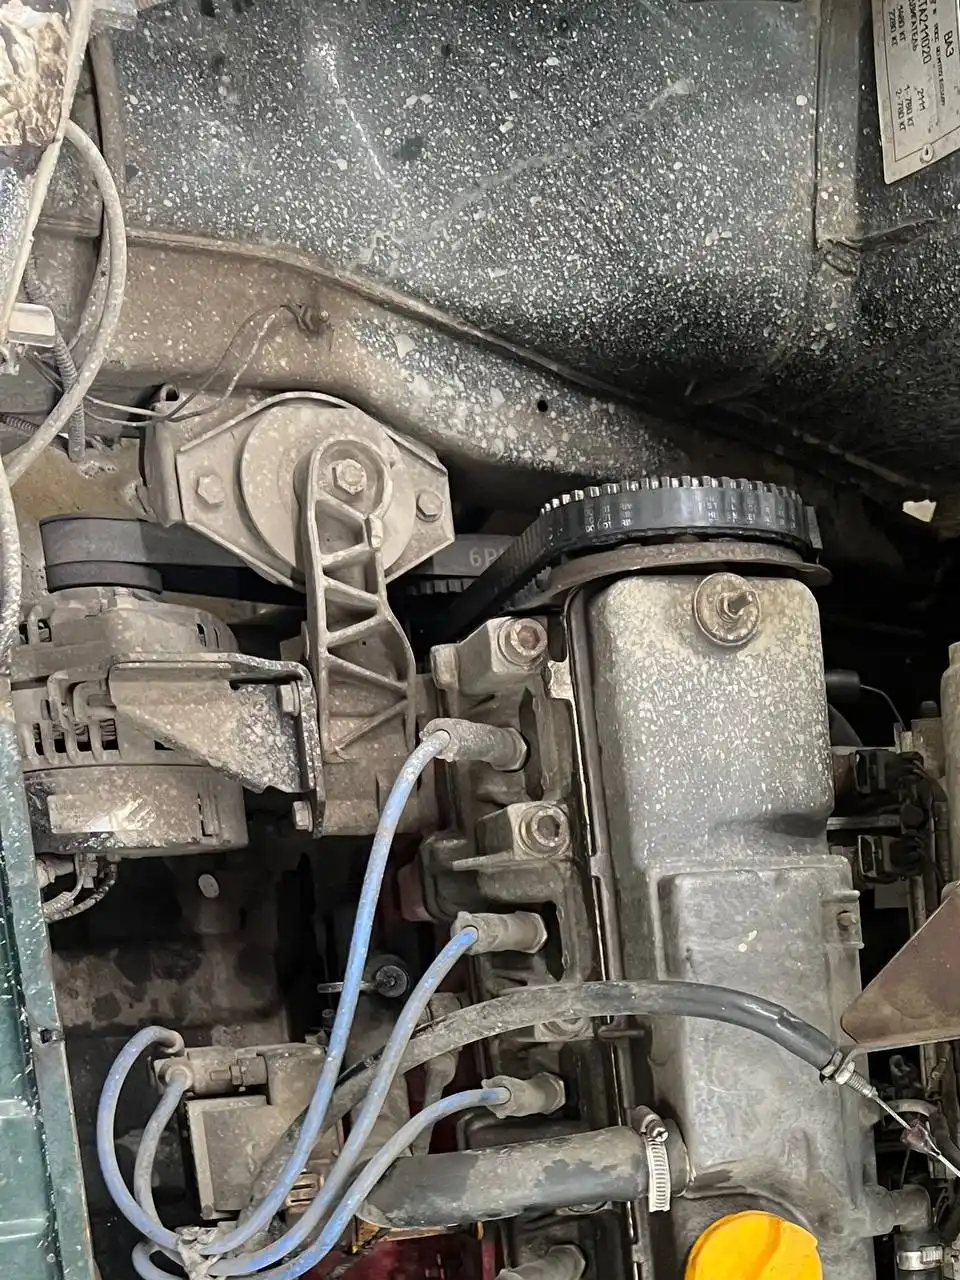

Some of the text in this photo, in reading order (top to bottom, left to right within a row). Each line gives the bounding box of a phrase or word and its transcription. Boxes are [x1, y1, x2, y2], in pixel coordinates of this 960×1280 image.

[918, 0, 932, 64] TA211020
[944, 30, 955, 58] ВАЗ
[469, 547, 504, 567] 6P
